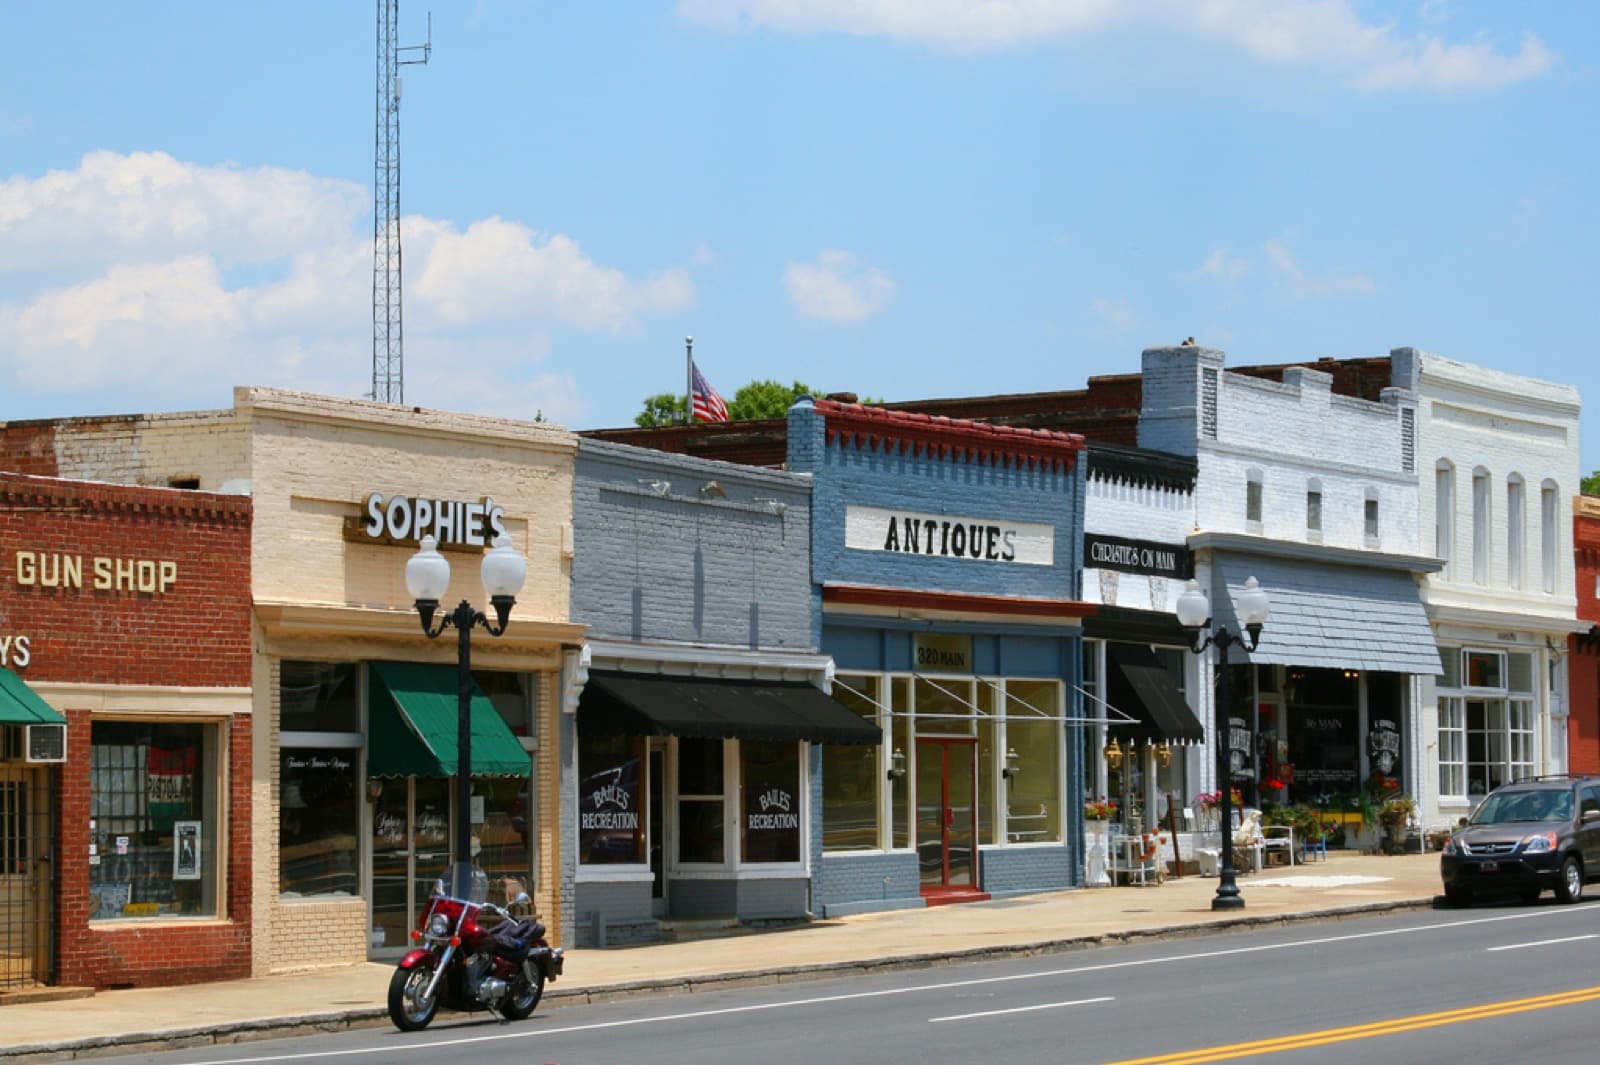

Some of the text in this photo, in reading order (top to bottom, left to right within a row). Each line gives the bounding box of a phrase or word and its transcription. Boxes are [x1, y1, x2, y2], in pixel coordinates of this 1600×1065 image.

[366, 491, 505, 548] SOPHIE'S
[884, 516, 1016, 561] ANTIQUES
[1140, 549, 1154, 567] ON
[1155, 551, 1176, 570] MAIN
[16, 551, 177, 593] GUN SHOP
[918, 648, 965, 667] 320 MAIN
[582, 812, 639, 830] RECREATION
[749, 813, 798, 829] RECREATION
